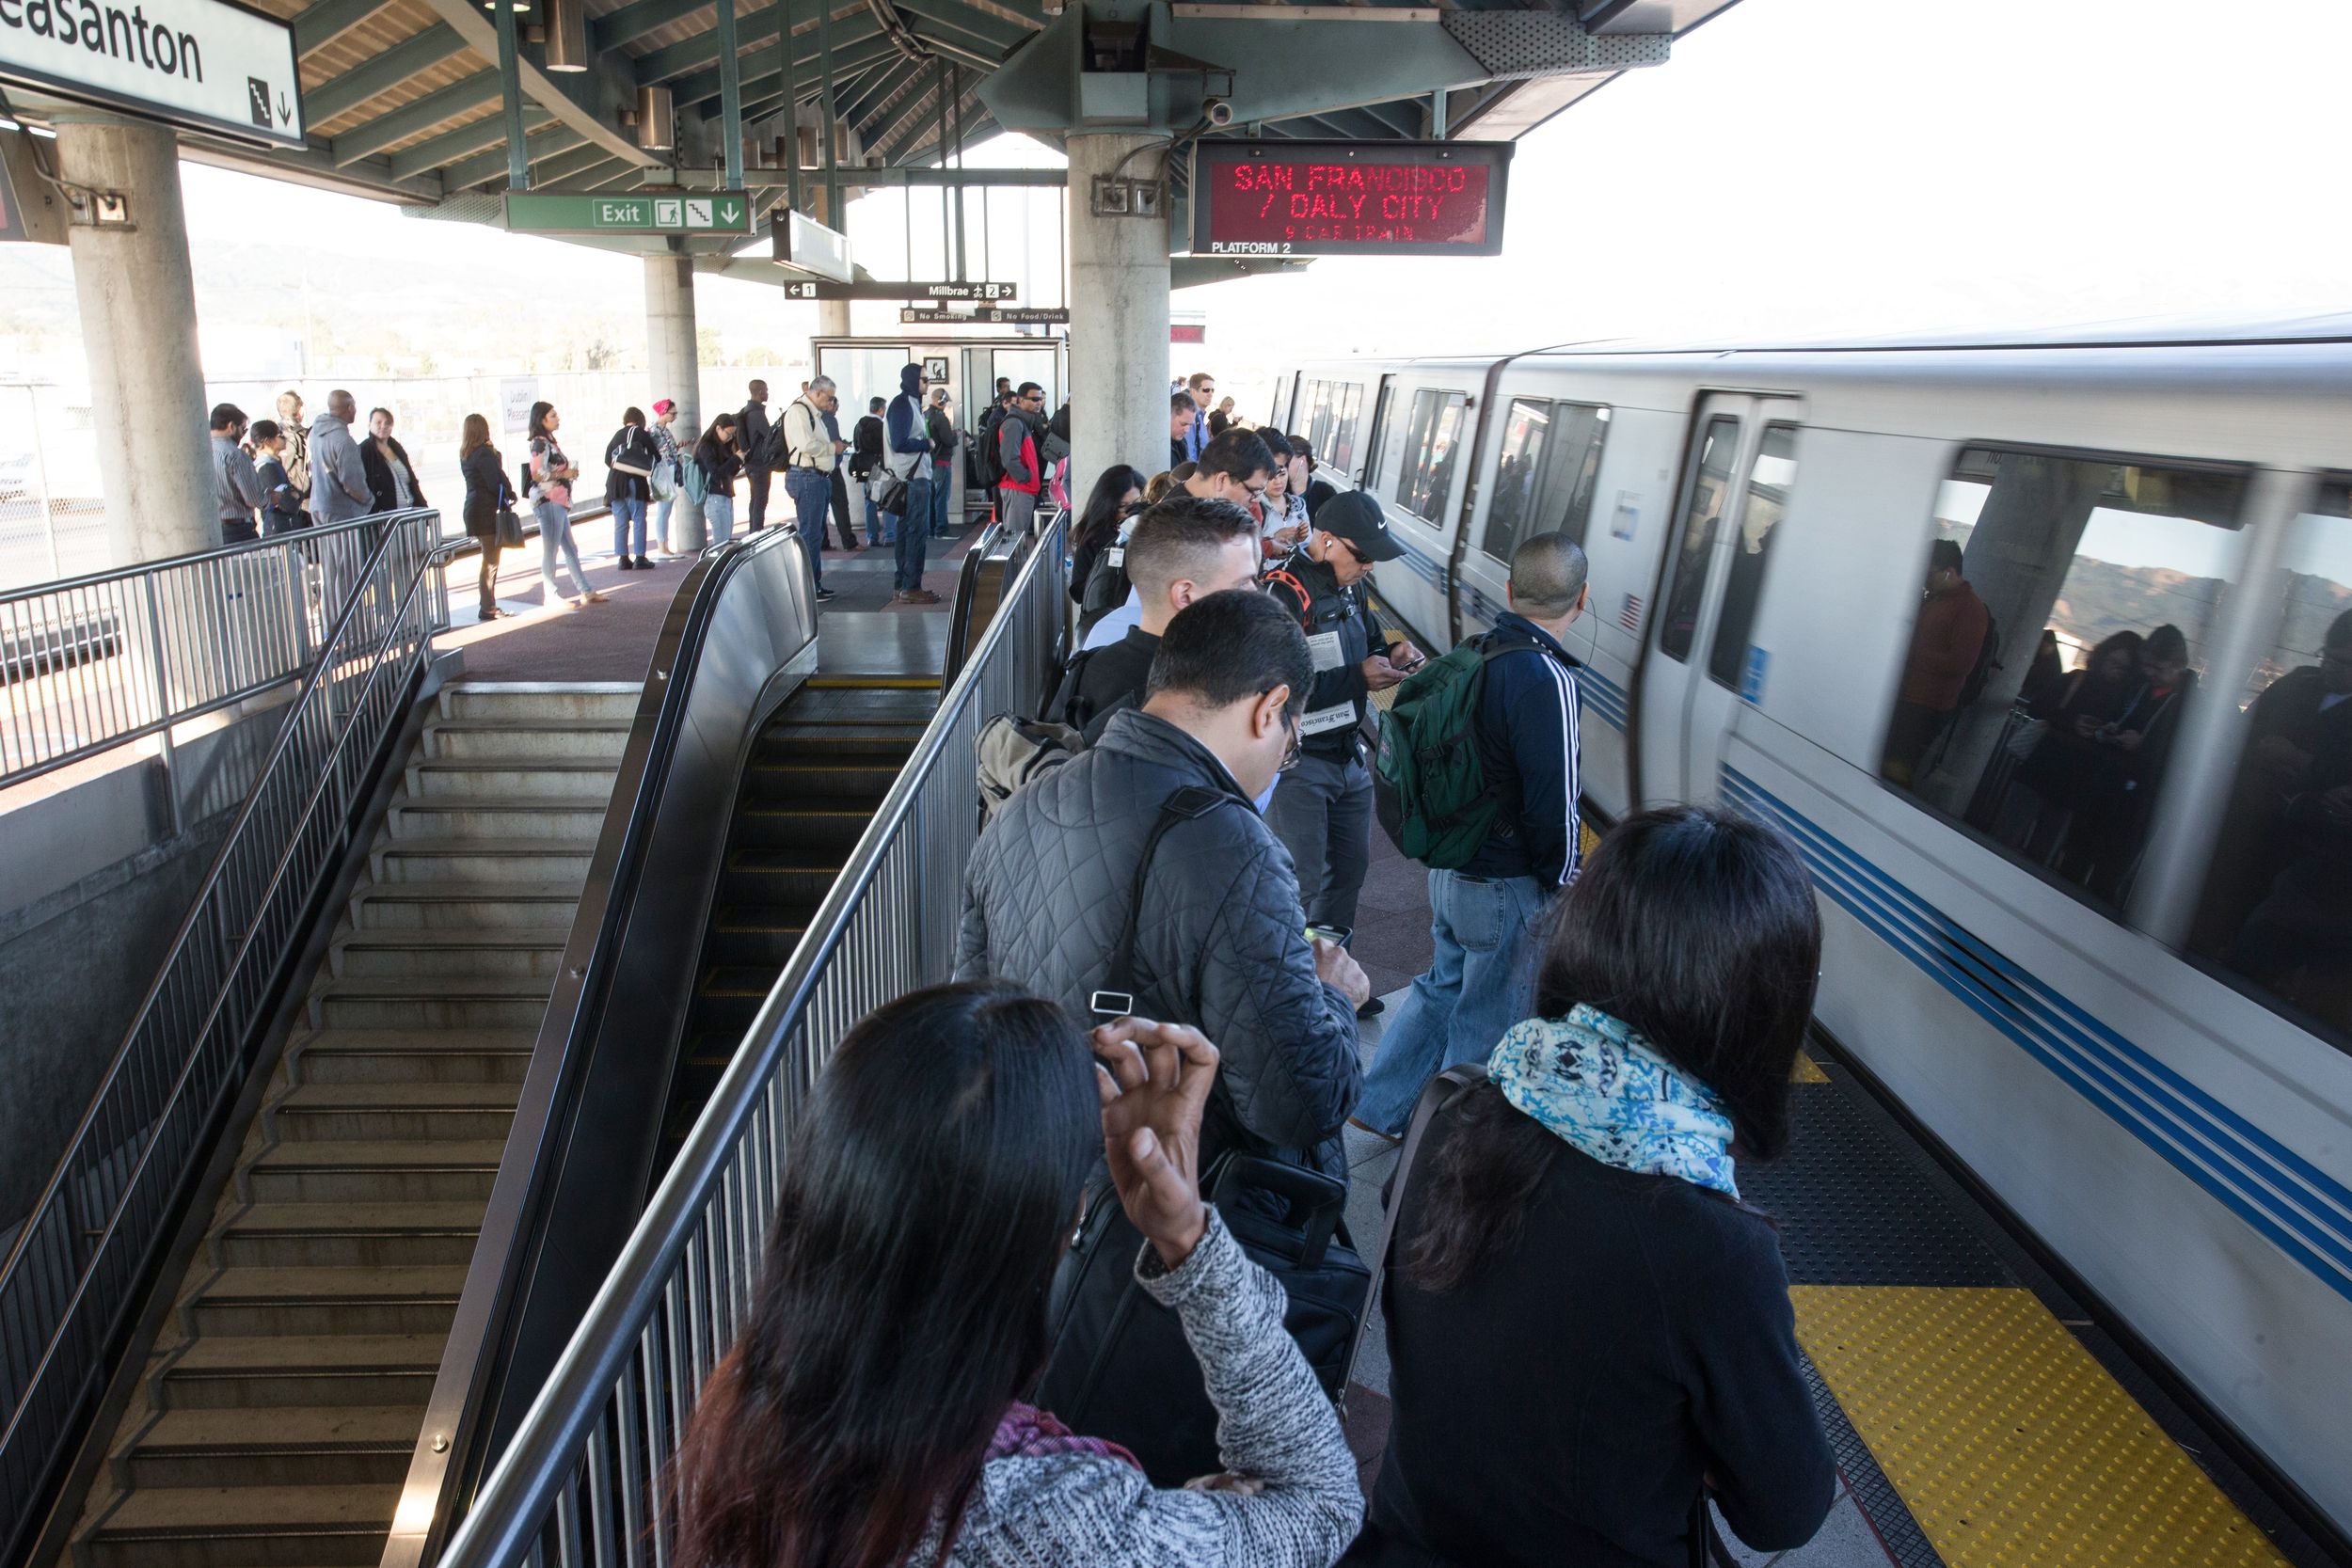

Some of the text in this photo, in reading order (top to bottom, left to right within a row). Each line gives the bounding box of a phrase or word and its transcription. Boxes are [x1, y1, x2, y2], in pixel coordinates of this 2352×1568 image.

[0, 0, 203, 83] easanton
[1234, 165, 1466, 192] SAN FRANCISCO
[602, 203, 641, 223] Exit
[1291, 193, 1367, 219] DALY
[1383, 194, 1444, 220] CITY
[1305, 225, 1341, 241] CAR
[1355, 225, 1414, 241] TRAIN
[1212, 242, 1291, 254] PLATFORM 2
[805, 285, 813, 296] 1
[929, 285, 969, 296] Millbrae
[988, 285, 995, 296] 2
[933, 312, 967, 322] Smoking
[1007, 312, 1064, 321] No Food/Drink
[507, 406, 530, 421] Pleasant
[1300, 709, 1350, 727] San Francisco
